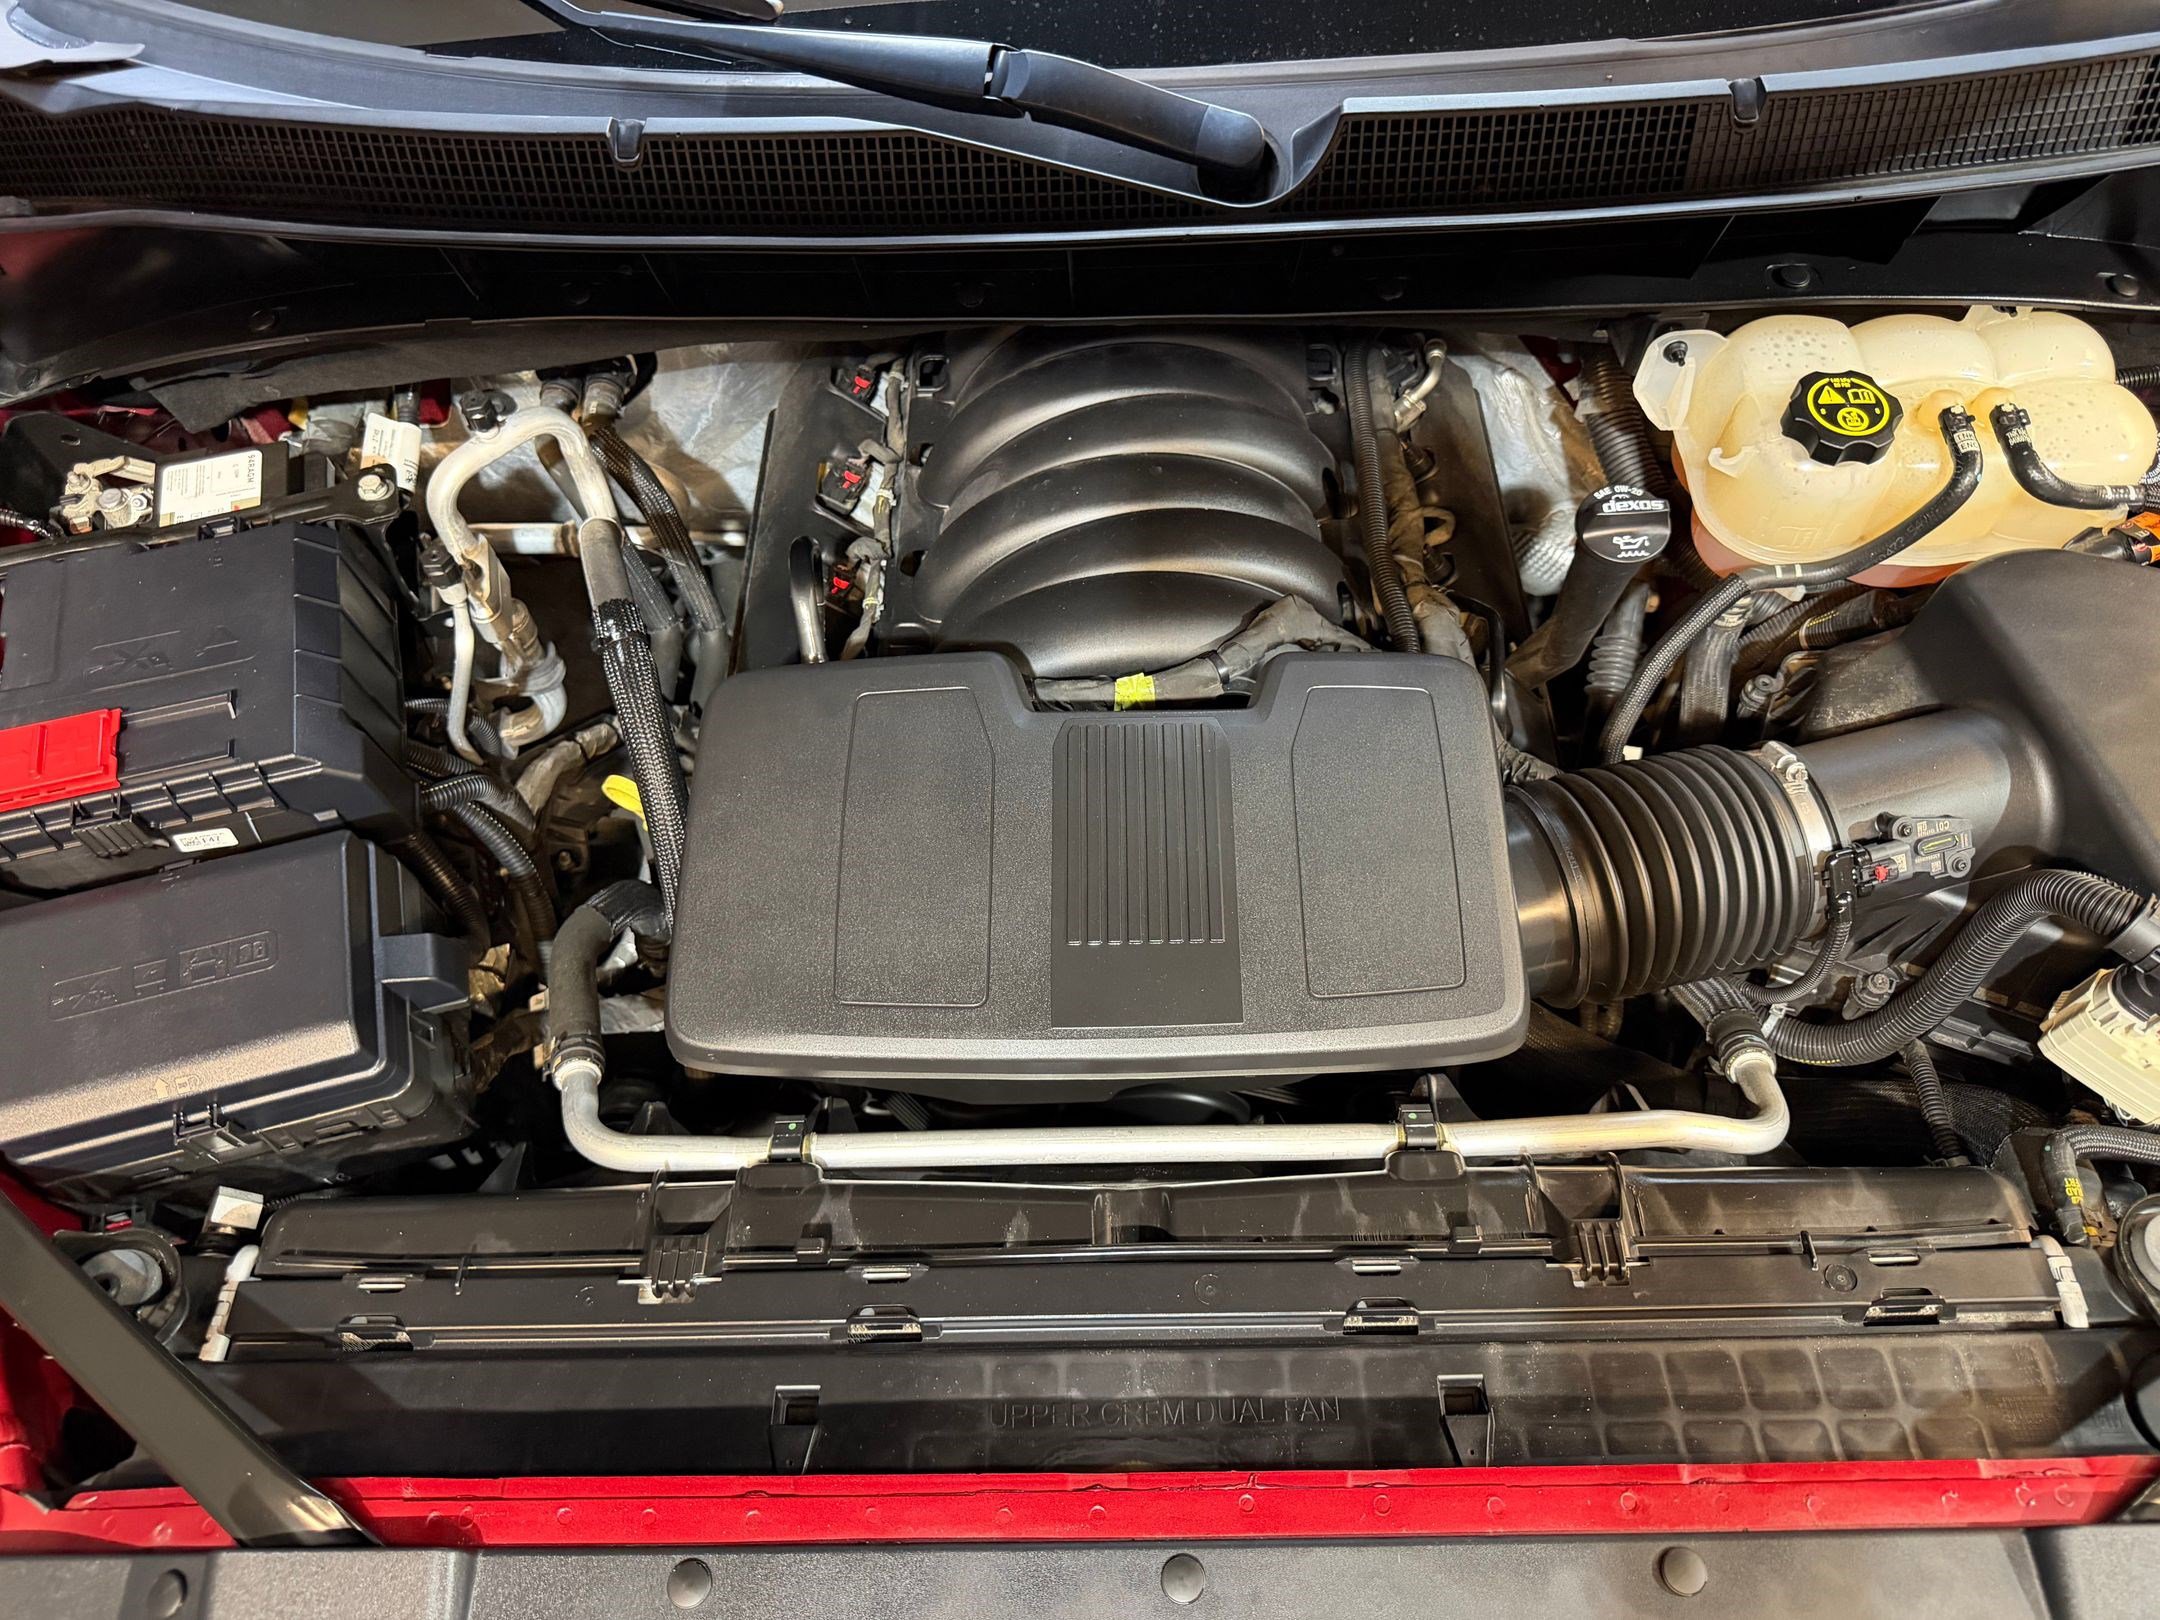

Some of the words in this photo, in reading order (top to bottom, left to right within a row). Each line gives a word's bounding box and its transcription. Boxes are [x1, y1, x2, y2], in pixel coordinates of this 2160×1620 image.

[1593, 486, 1612, 499] SAE
[1613, 485, 1643, 496] 0W-20
[1602, 498, 1665, 513] dexos
[988, 1402, 1092, 1429] UPPER
[1197, 1397, 1276, 1425] DUAL
[1284, 1395, 1341, 1423] FAN
